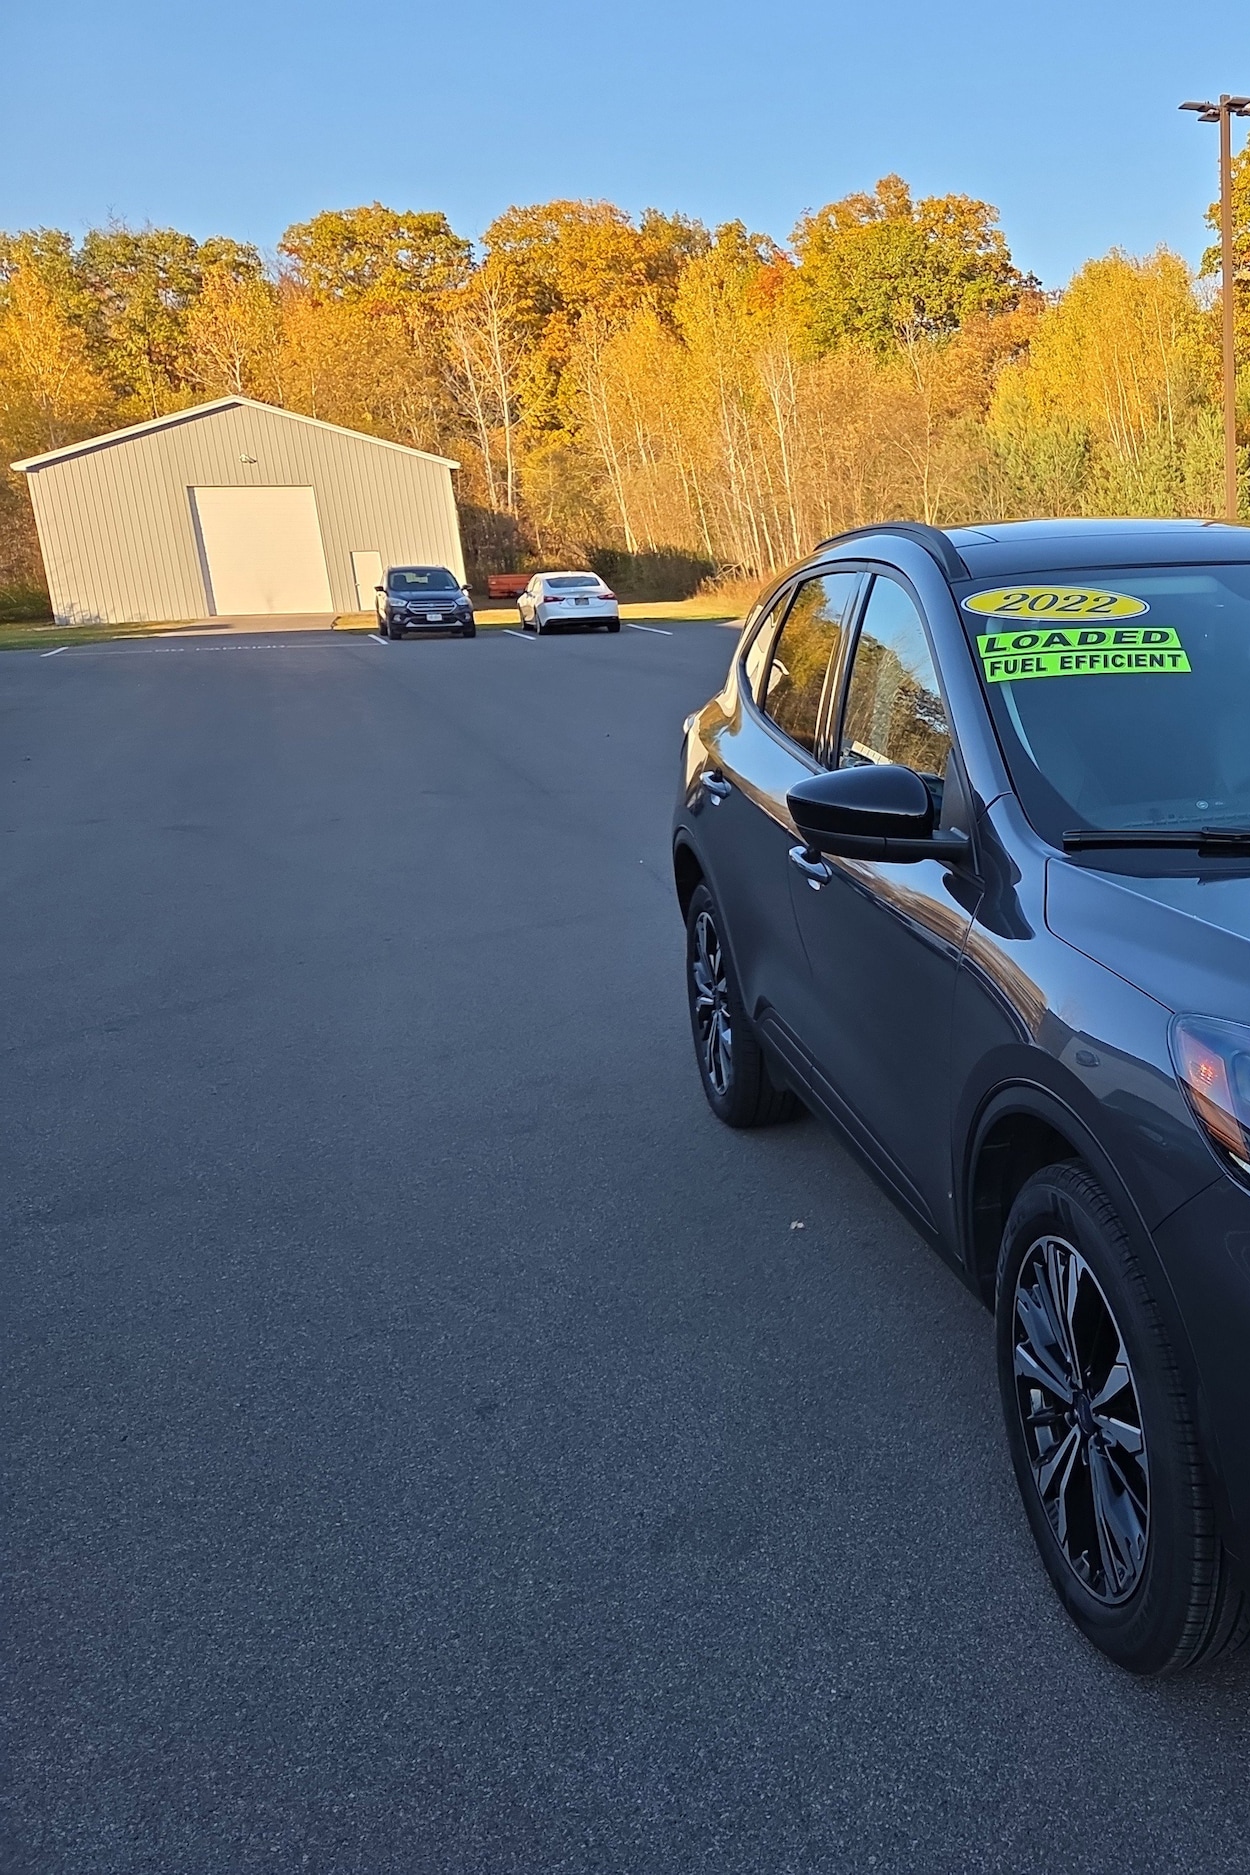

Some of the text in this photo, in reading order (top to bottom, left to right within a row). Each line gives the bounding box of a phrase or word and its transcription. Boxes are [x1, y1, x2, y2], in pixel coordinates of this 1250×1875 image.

[994, 592, 1119, 615] 2022
[983, 629, 1171, 654] LOADED
[989, 652, 1183, 677] FUEL EFFICIENT
